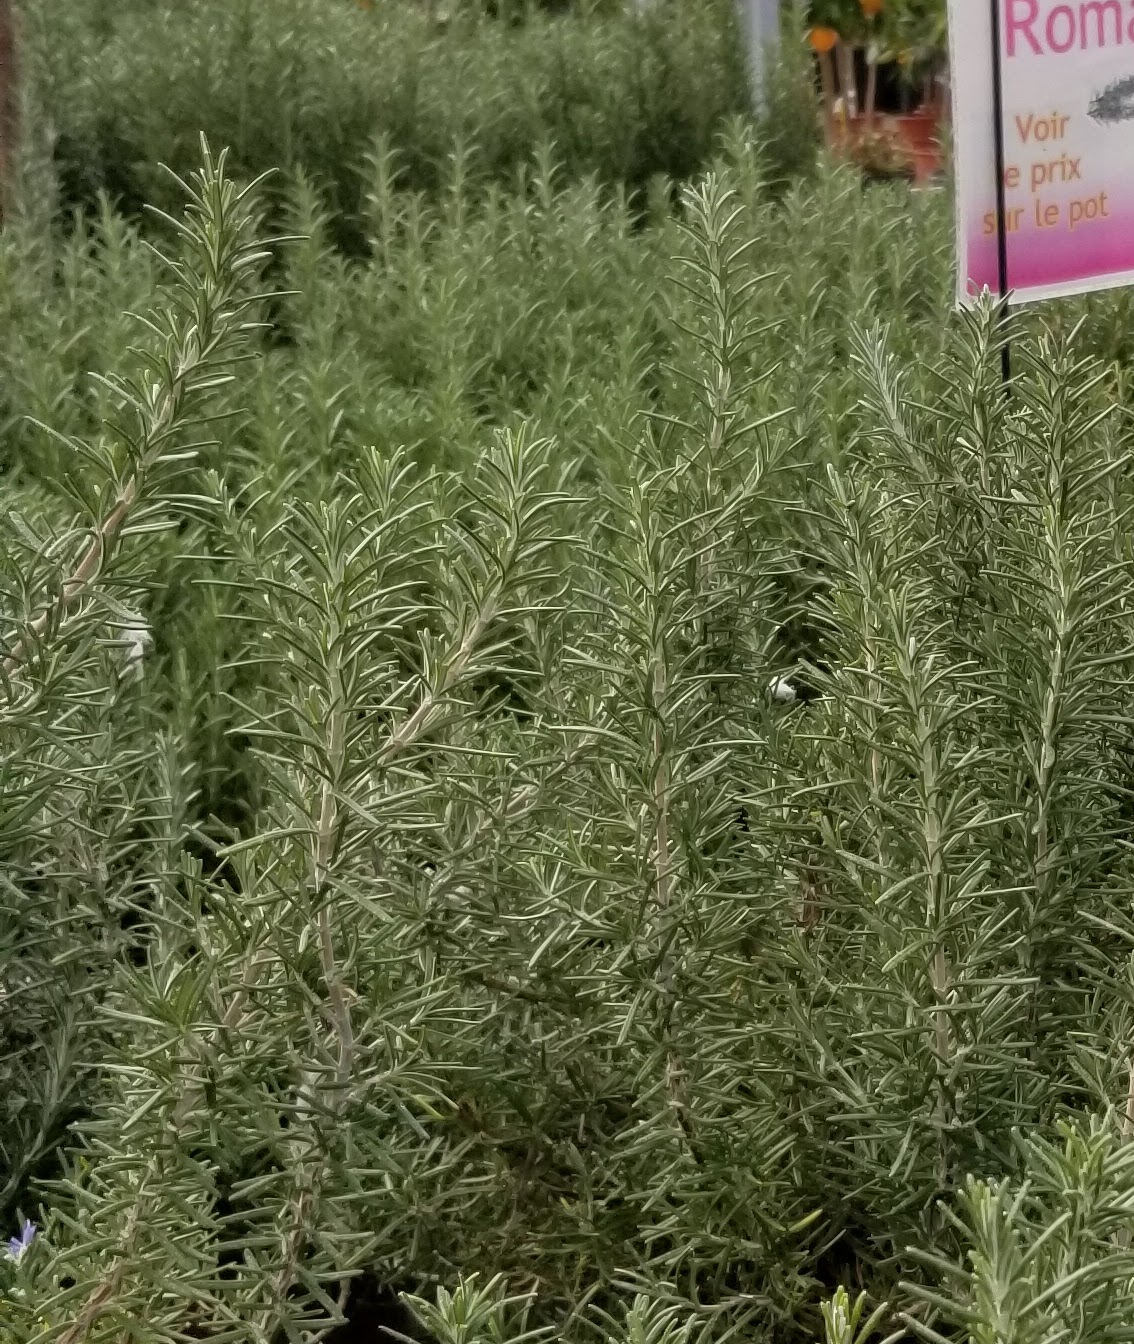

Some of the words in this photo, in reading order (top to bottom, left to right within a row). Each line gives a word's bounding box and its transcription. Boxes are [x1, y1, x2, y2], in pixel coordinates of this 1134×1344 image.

[1015, 111, 1071, 143] Voir
[1031, 153, 1081, 192] prix
[1035, 199, 1059, 227] le
[1069, 191, 1109, 229] pot
